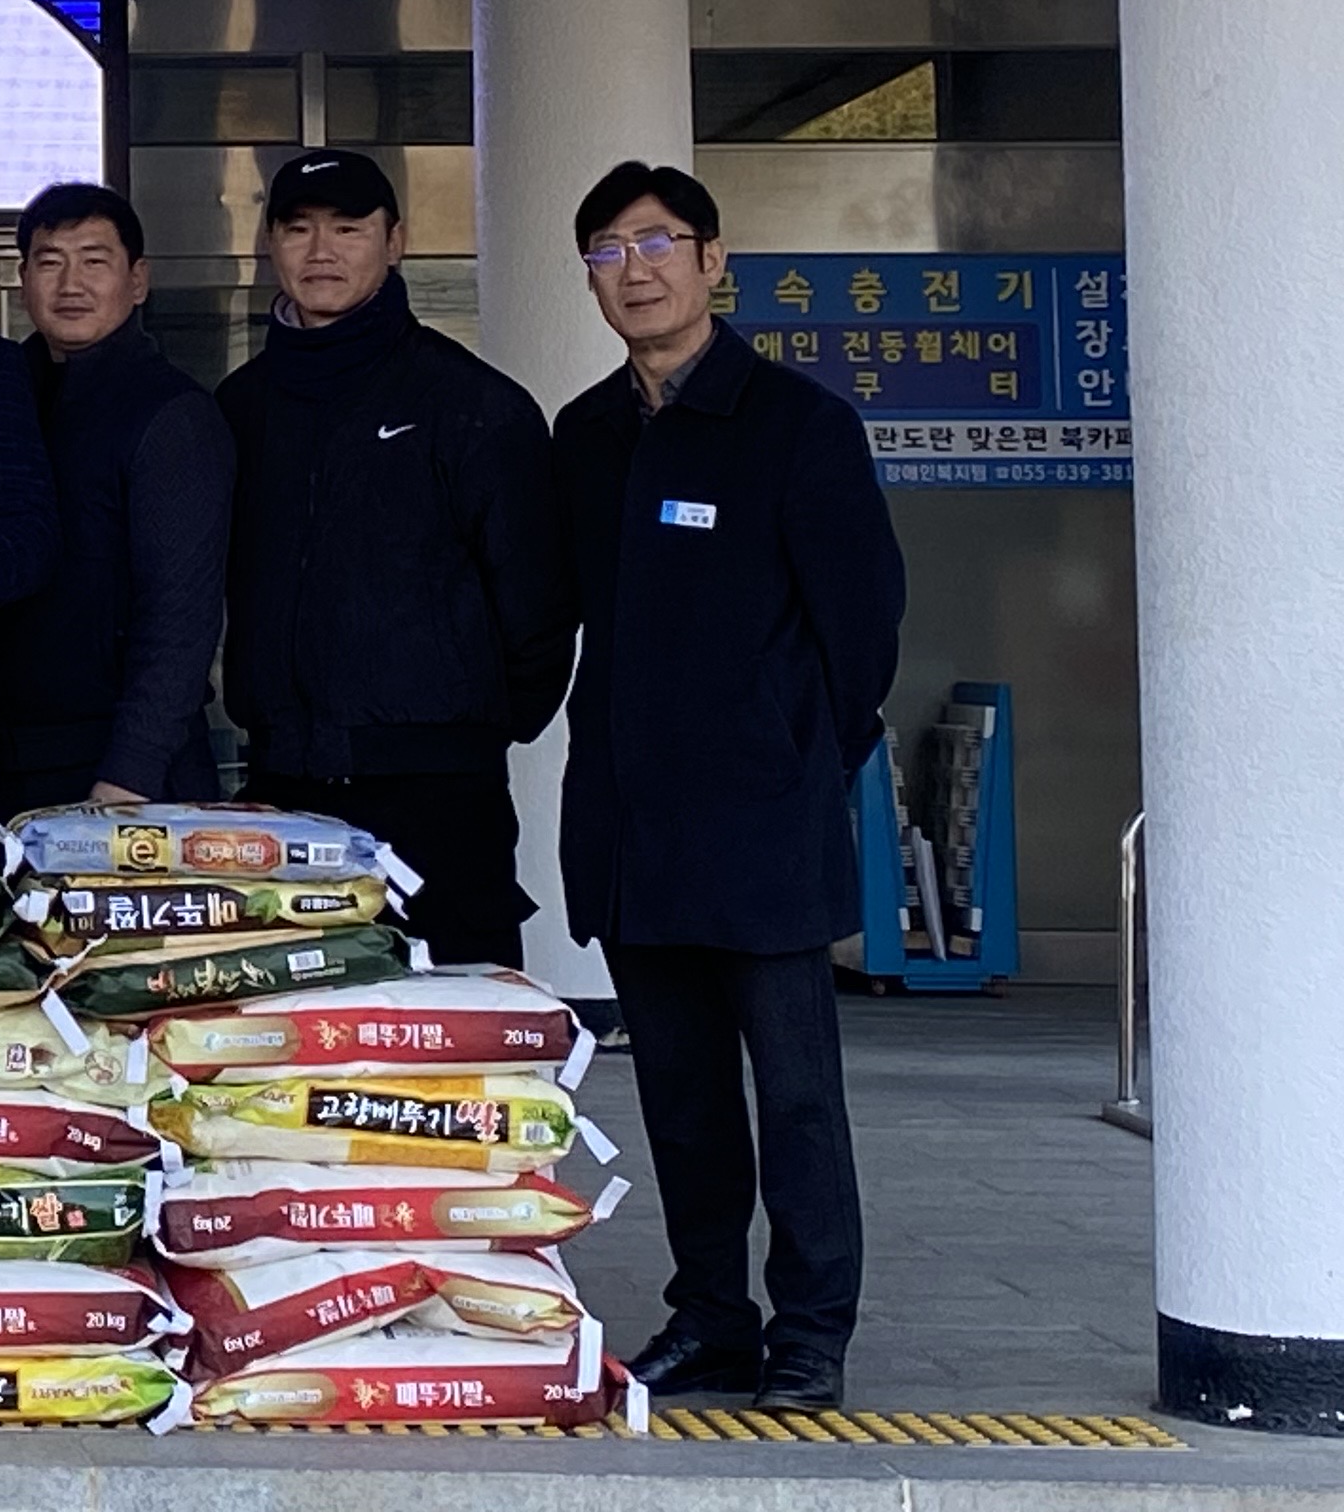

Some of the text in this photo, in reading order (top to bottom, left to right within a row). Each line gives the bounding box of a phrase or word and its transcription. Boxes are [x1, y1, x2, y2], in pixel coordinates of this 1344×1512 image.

[753, 330, 1018, 363] 애인 전동휠체어
[853, 371, 1018, 401] 쿠터
[873, 426, 955, 452] 란도란
[966, 426, 1048, 452] 맞은편
[1011, 464, 1132, 482] 055-639-381
[357, 1023, 445, 1050] 메뚜기쌀
[396, 1380, 485, 1408] 메뚜기쌀
